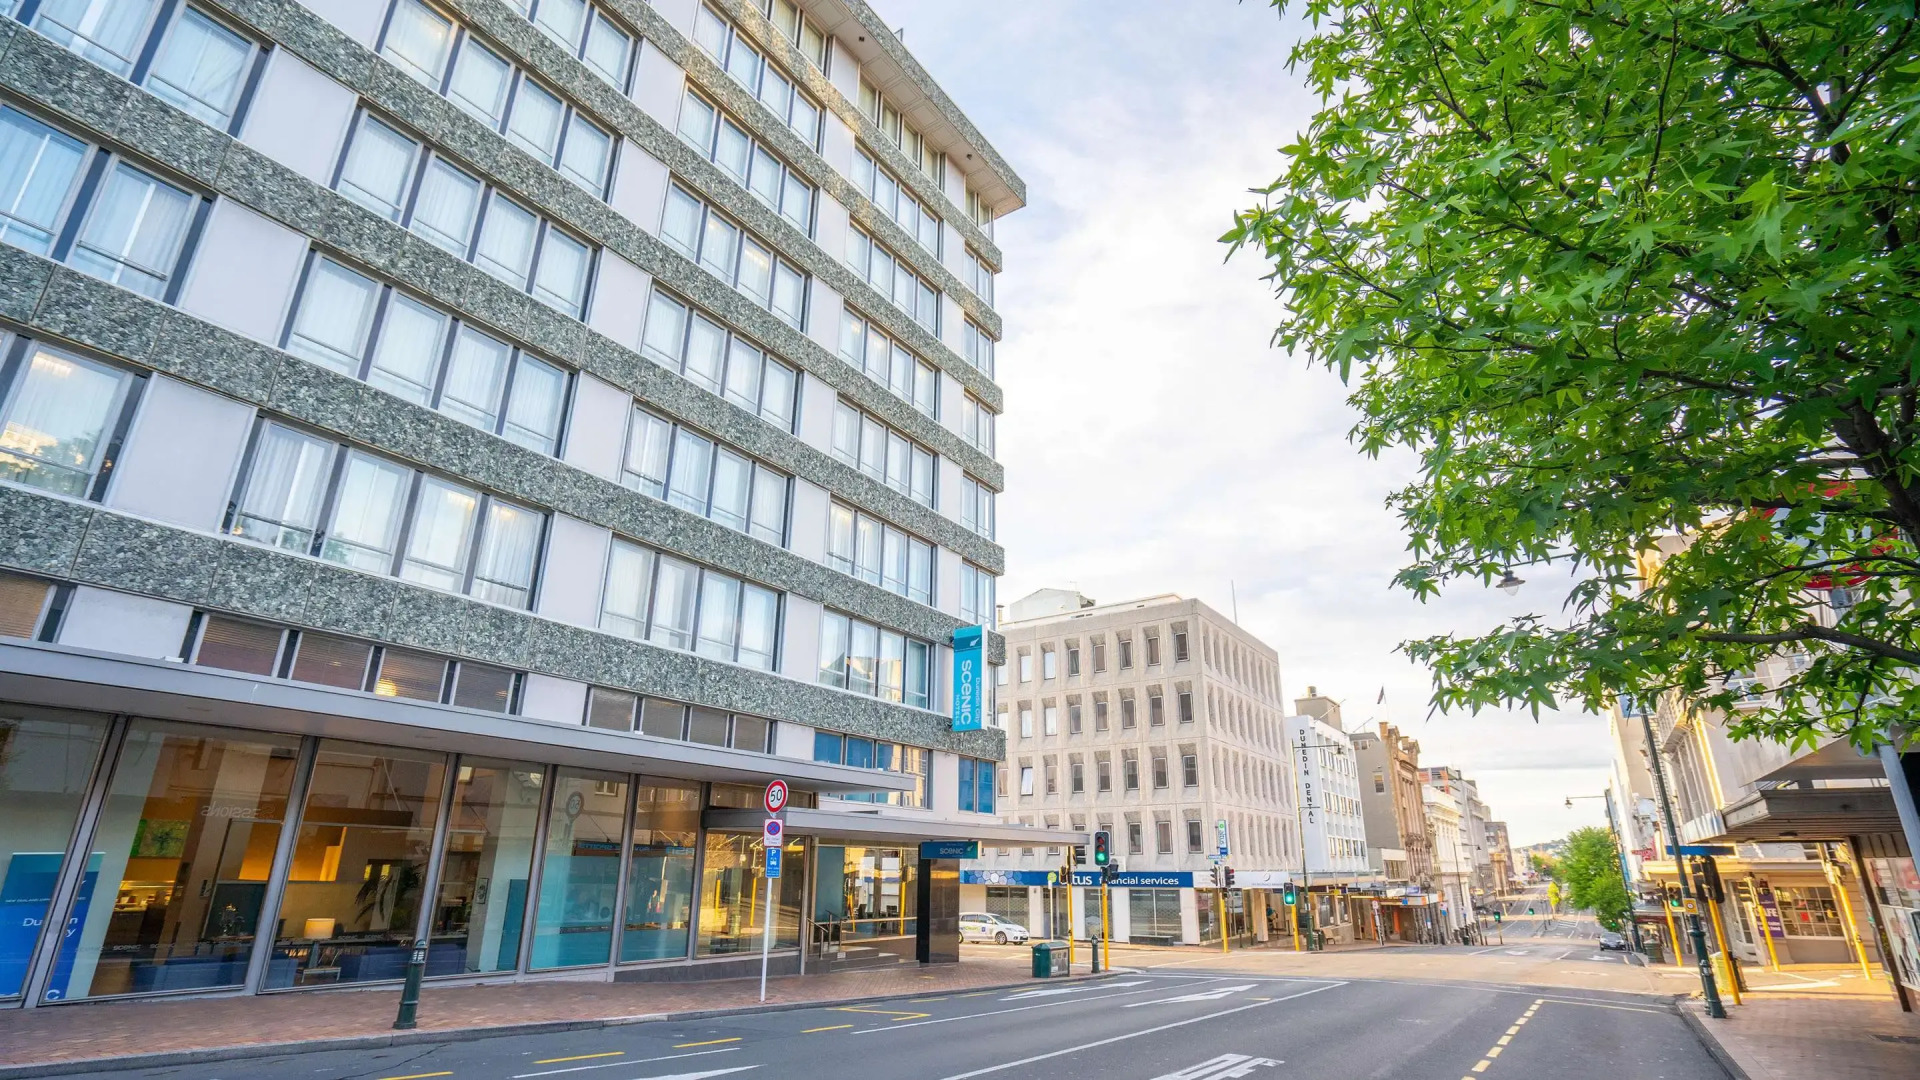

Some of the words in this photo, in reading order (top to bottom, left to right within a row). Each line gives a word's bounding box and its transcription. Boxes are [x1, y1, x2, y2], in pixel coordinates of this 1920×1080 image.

[1299, 729, 1310, 776] DUNEDIN
[770, 789, 782, 803] 50
[1304, 782, 1314, 824] DENTAL
[771, 849, 776, 857] P
[1140, 877, 1179, 885] services
